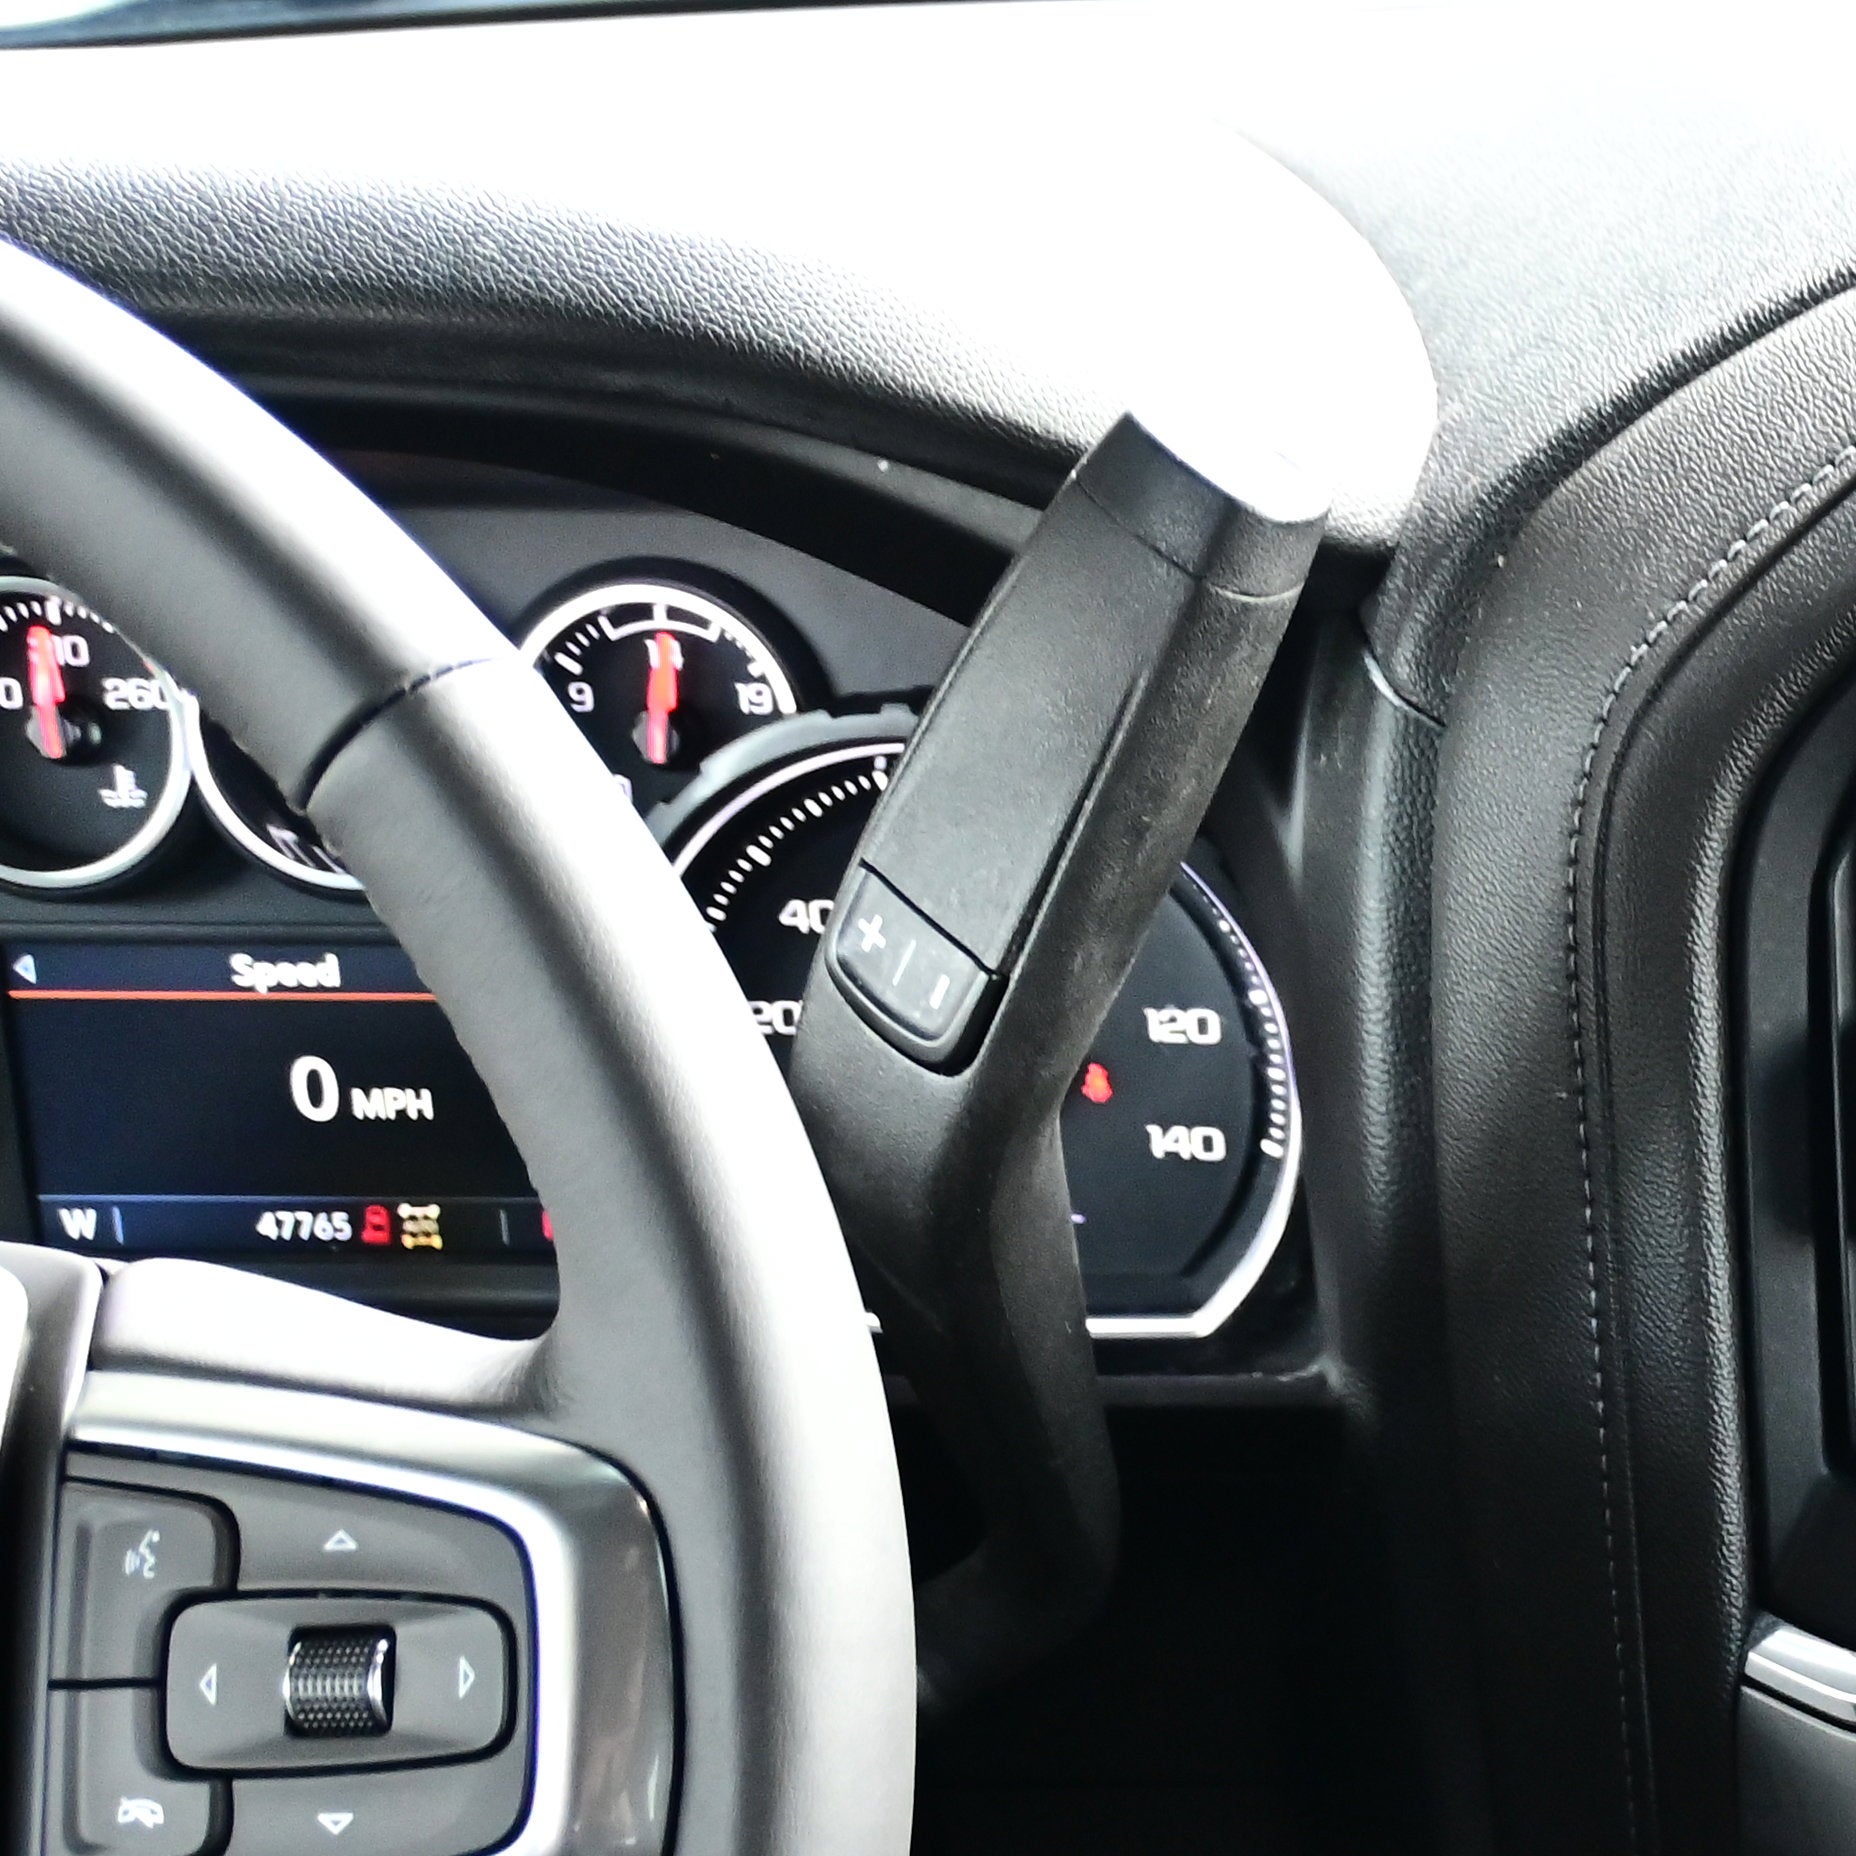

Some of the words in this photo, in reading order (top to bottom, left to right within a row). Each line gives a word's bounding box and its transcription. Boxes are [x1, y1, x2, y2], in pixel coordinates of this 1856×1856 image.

[567, 681, 595, 713] 9
[734, 682, 774, 715] 19
[779, 899, 834, 934] 40
[230, 952, 342, 994] Speed
[1143, 1006, 1222, 1045] 120
[289, 1055, 340, 1122] 0
[350, 1087, 434, 1121] MPH
[1145, 1124, 1227, 1162] 140
[58, 1208, 97, 1240] W
[255, 1210, 353, 1241] 47765
